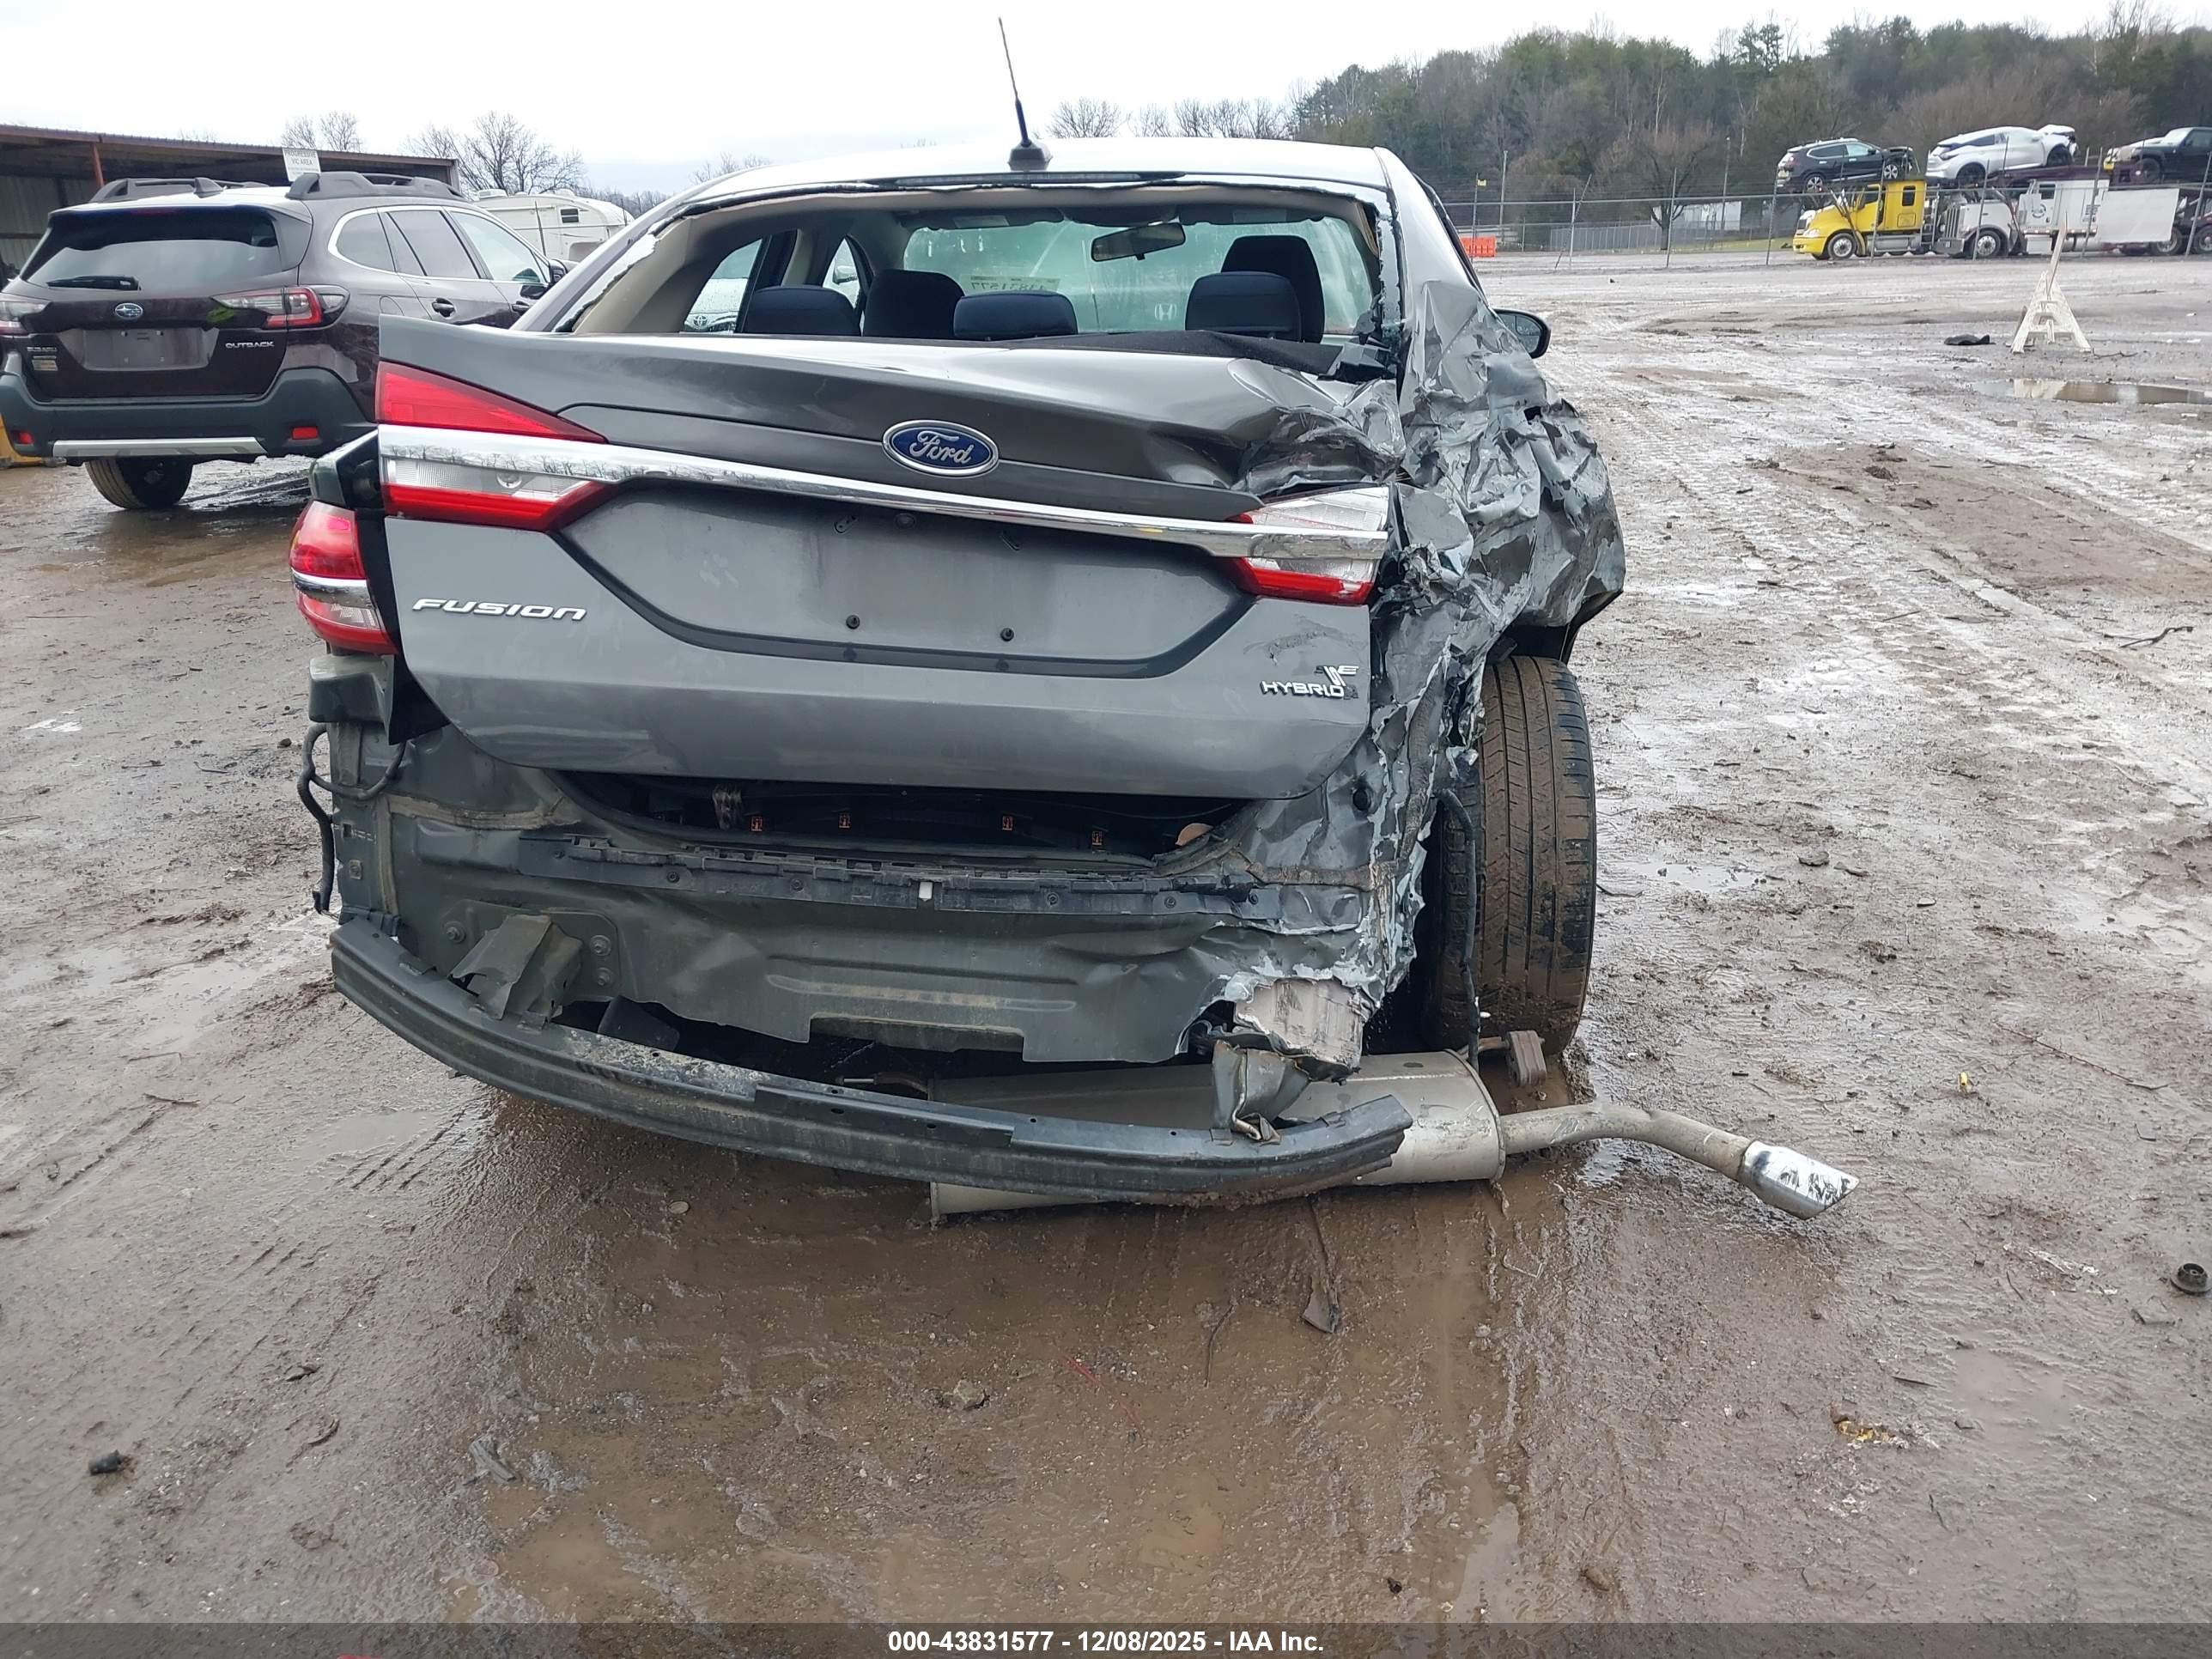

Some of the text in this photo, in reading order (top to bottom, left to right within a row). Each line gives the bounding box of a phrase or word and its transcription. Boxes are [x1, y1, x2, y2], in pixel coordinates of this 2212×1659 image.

[908, 430, 975, 465] Ford
[412, 599, 587, 621] FUSION
[1261, 681, 1345, 698] HYBRID
